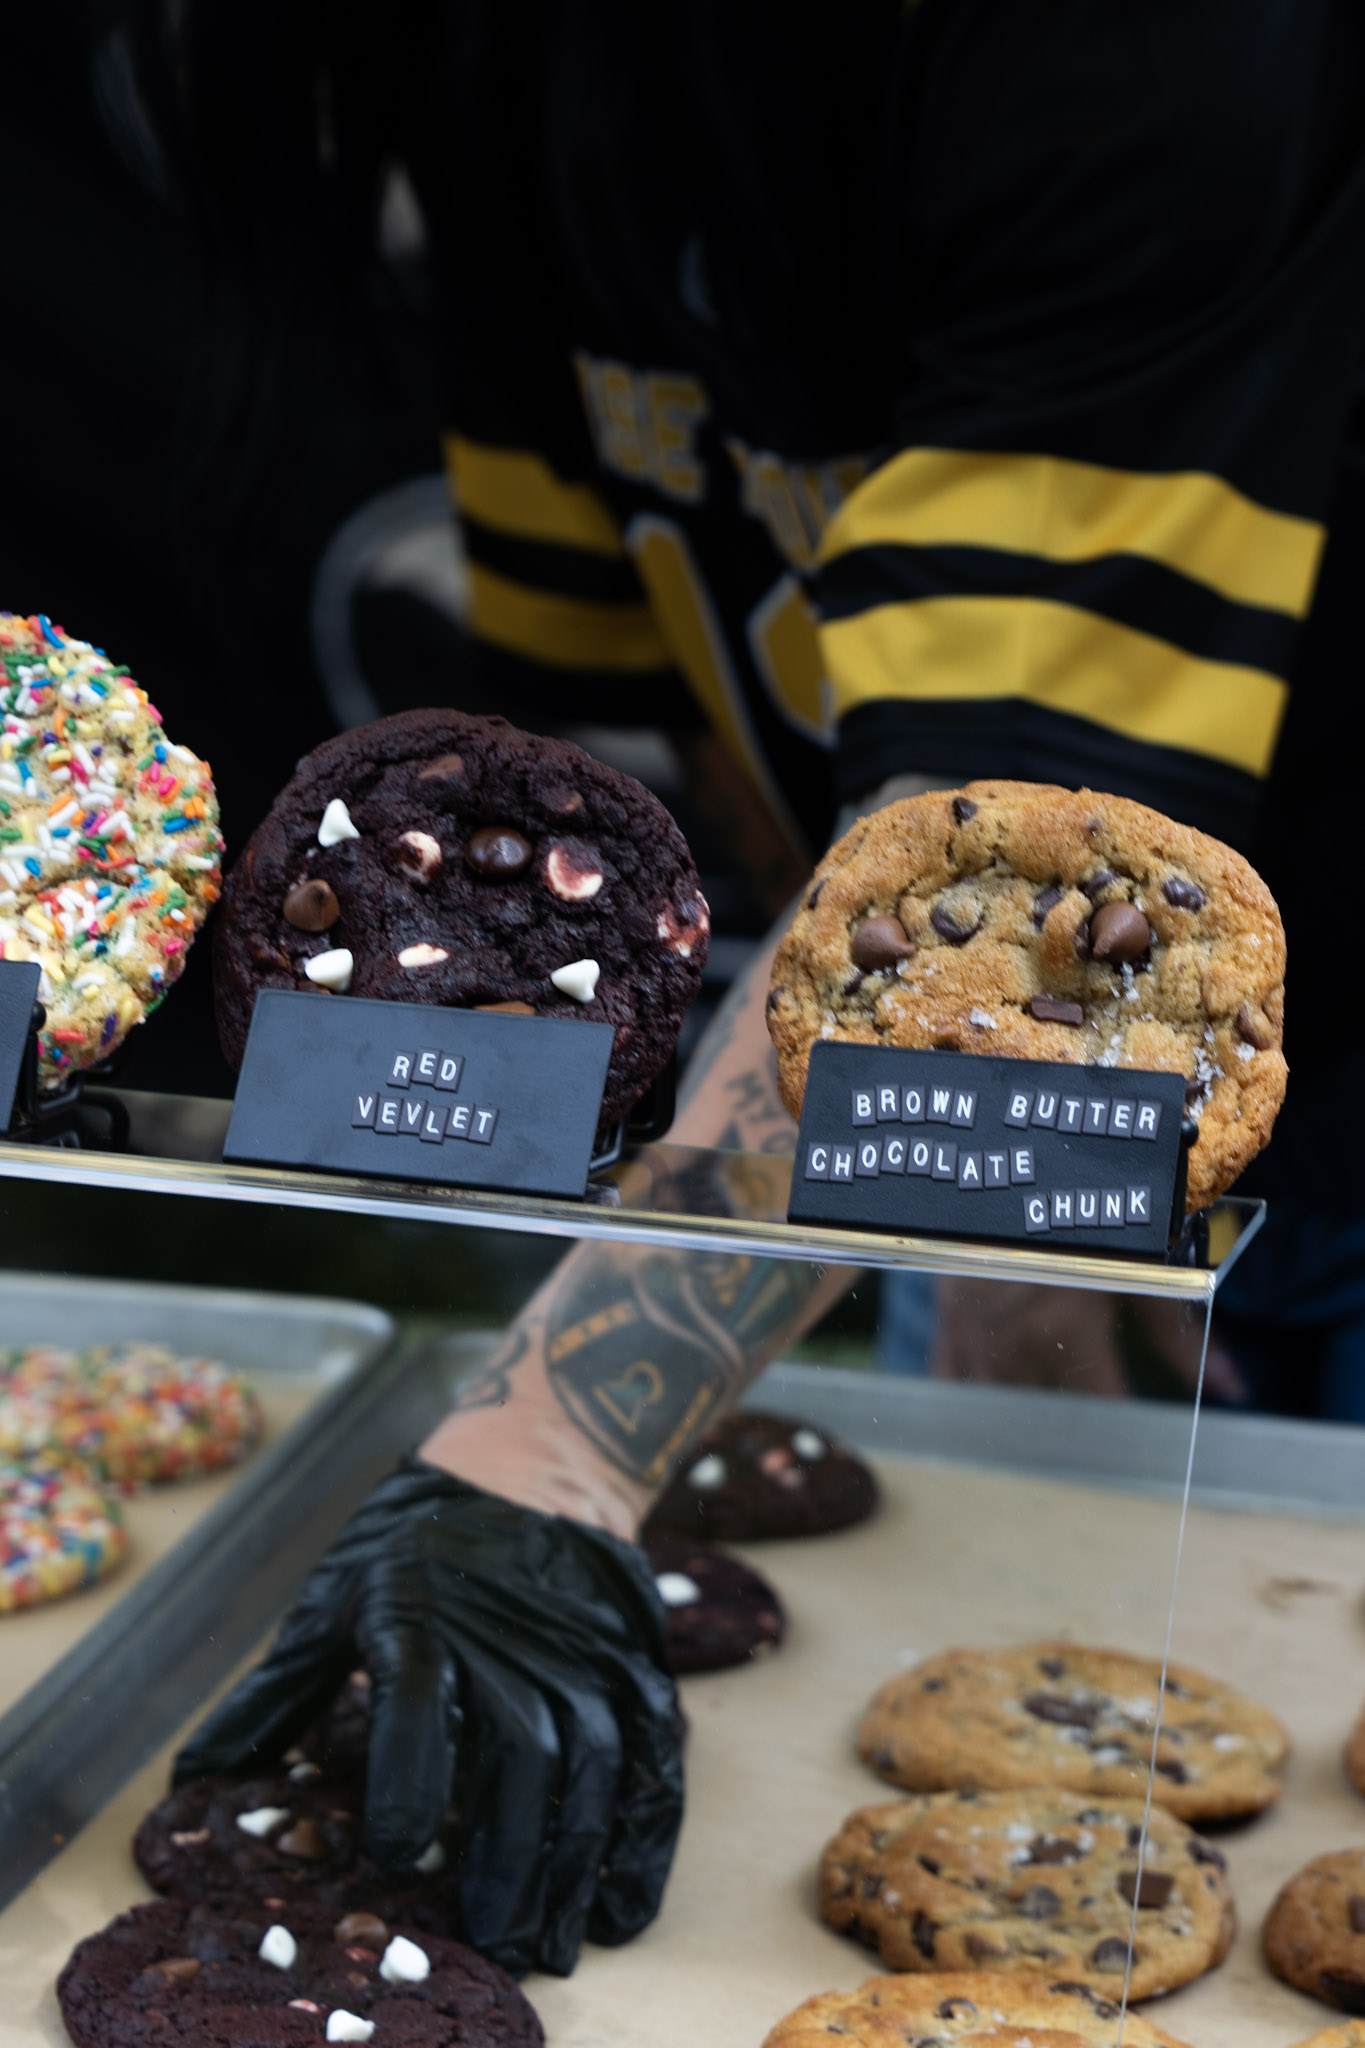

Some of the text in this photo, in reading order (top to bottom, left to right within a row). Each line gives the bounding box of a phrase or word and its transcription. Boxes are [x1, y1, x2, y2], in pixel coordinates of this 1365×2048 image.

[391, 1051, 458, 1083] RED
[357, 1094, 494, 1136] VEVLET
[855, 1087, 1157, 1132] BROWN BUTTER
[810, 1139, 1031, 1182] CHOCOLATE
[1027, 1189, 1147, 1225] CHUNK
